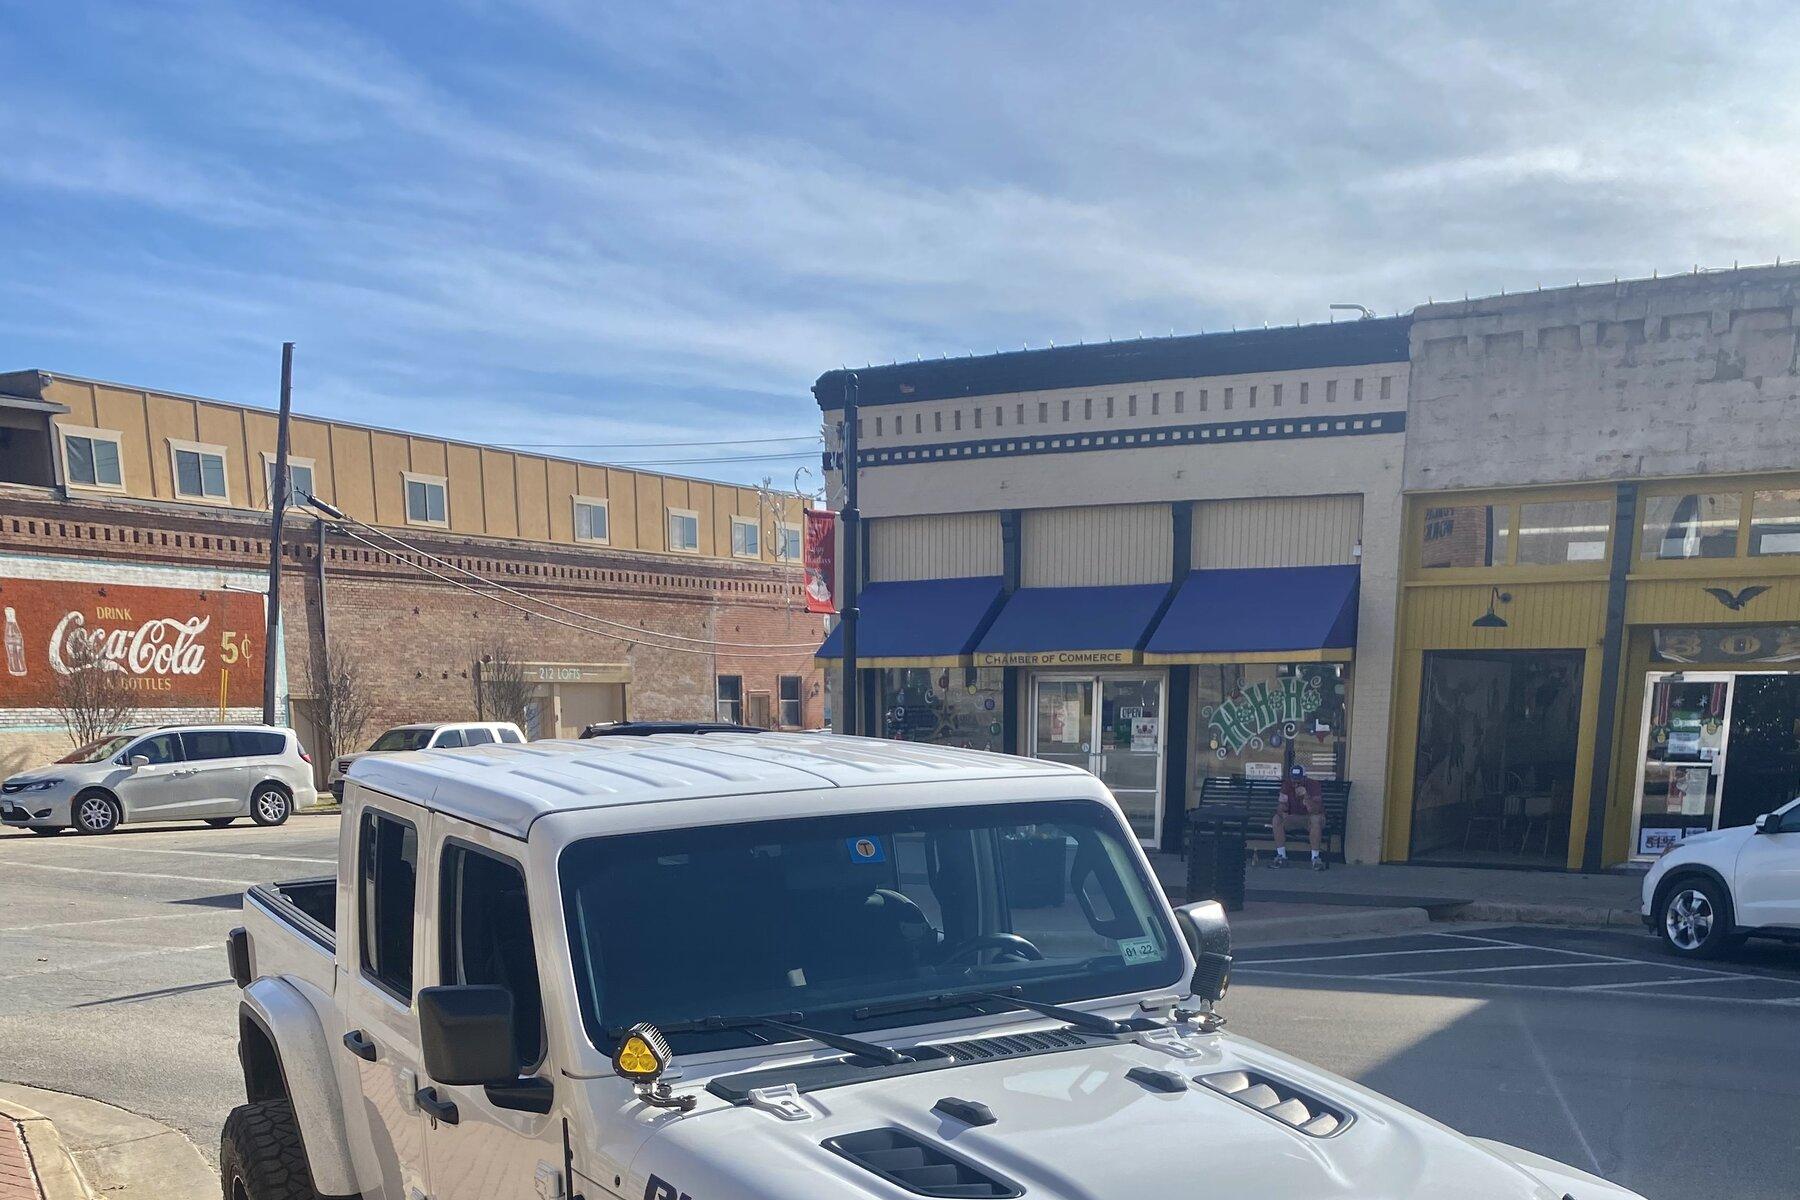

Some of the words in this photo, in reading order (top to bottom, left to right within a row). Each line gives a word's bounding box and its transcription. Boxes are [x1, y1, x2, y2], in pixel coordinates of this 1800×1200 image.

[96, 606, 133, 621] DRINK
[48, 610, 211, 676] Coca-Cola
[985, 654, 1039, 665] CHAMBER
[1041, 654, 1056, 664] OF
[1059, 652, 1123, 663] COMMERCE
[540, 668, 554, 679] 212
[557, 668, 581, 680] LOFTS
[1140, 944, 1153, 955] 22
